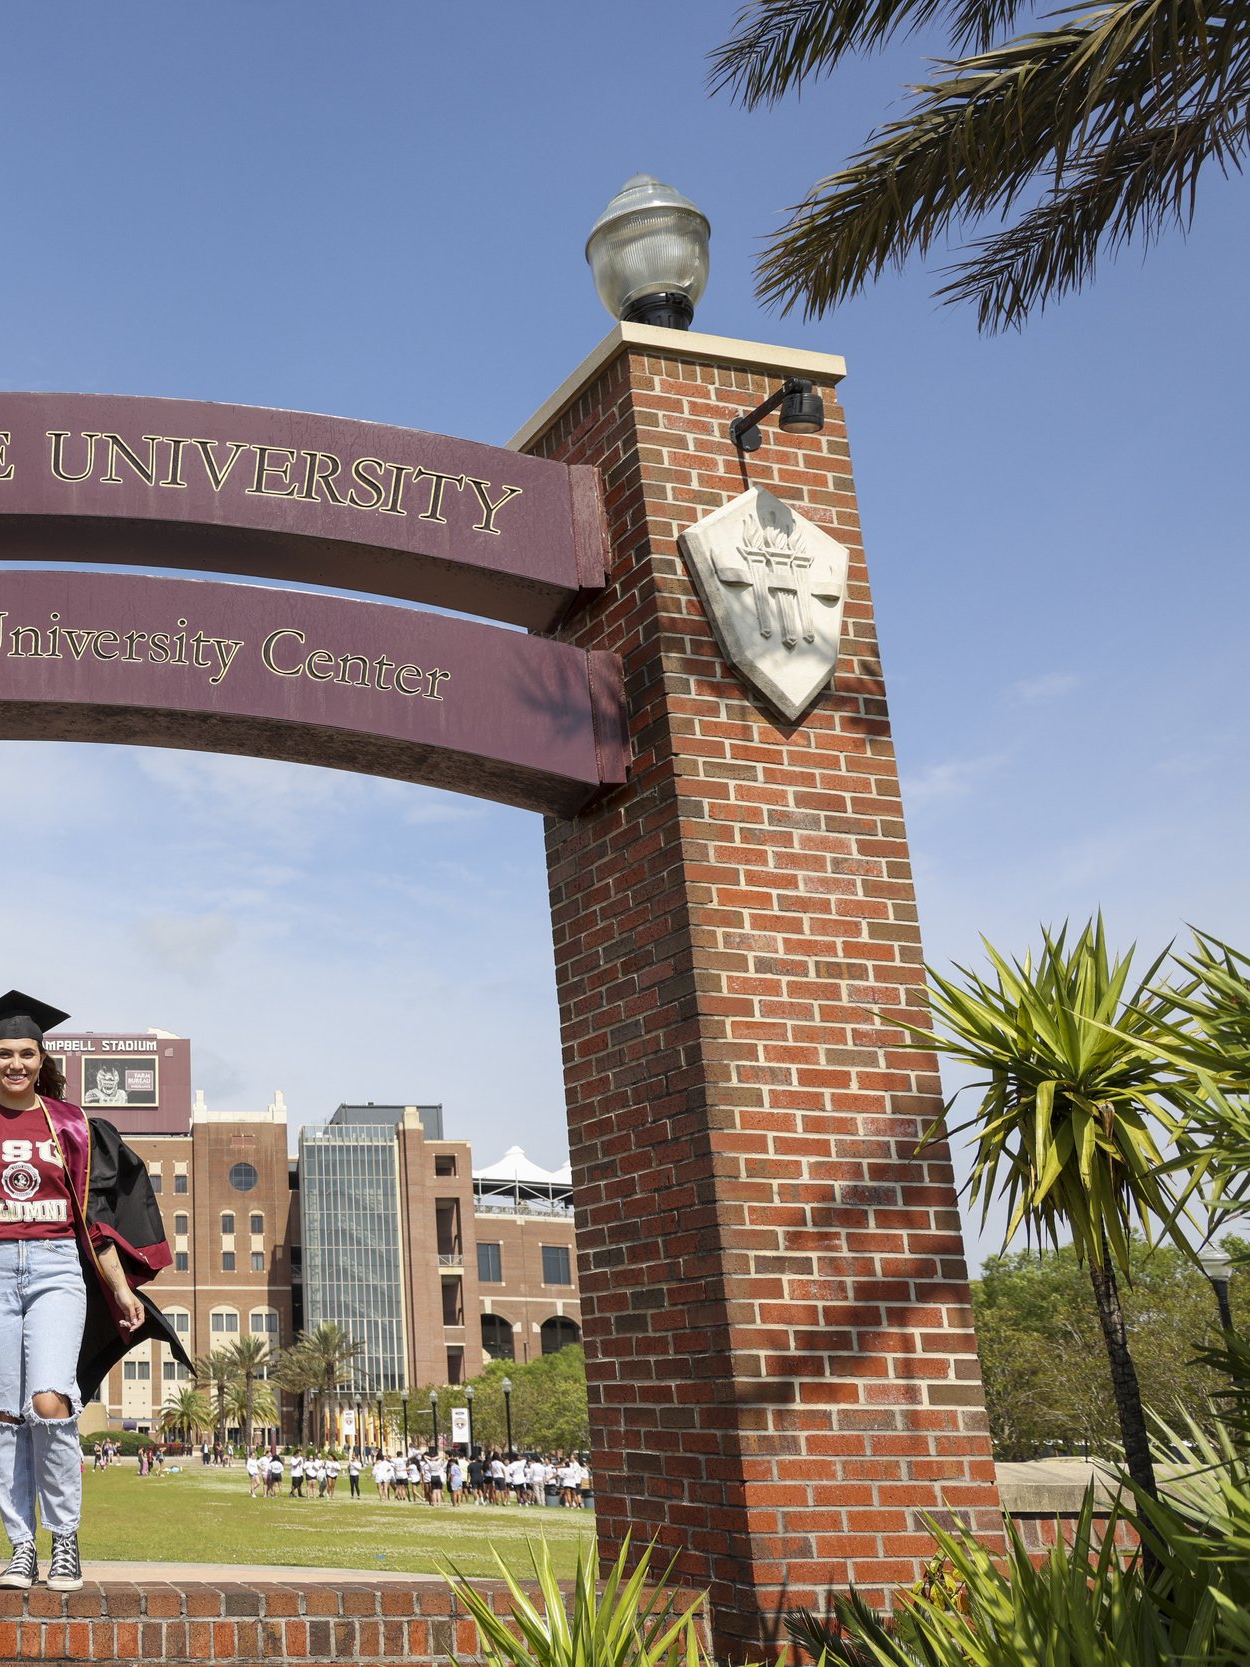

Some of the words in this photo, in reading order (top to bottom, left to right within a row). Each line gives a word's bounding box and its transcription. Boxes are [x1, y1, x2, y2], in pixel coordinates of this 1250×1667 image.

[46, 430, 523, 535] UNIVERSITY
[261, 628, 451, 701] Center
[102, 1040, 157, 1051] STADIUM
